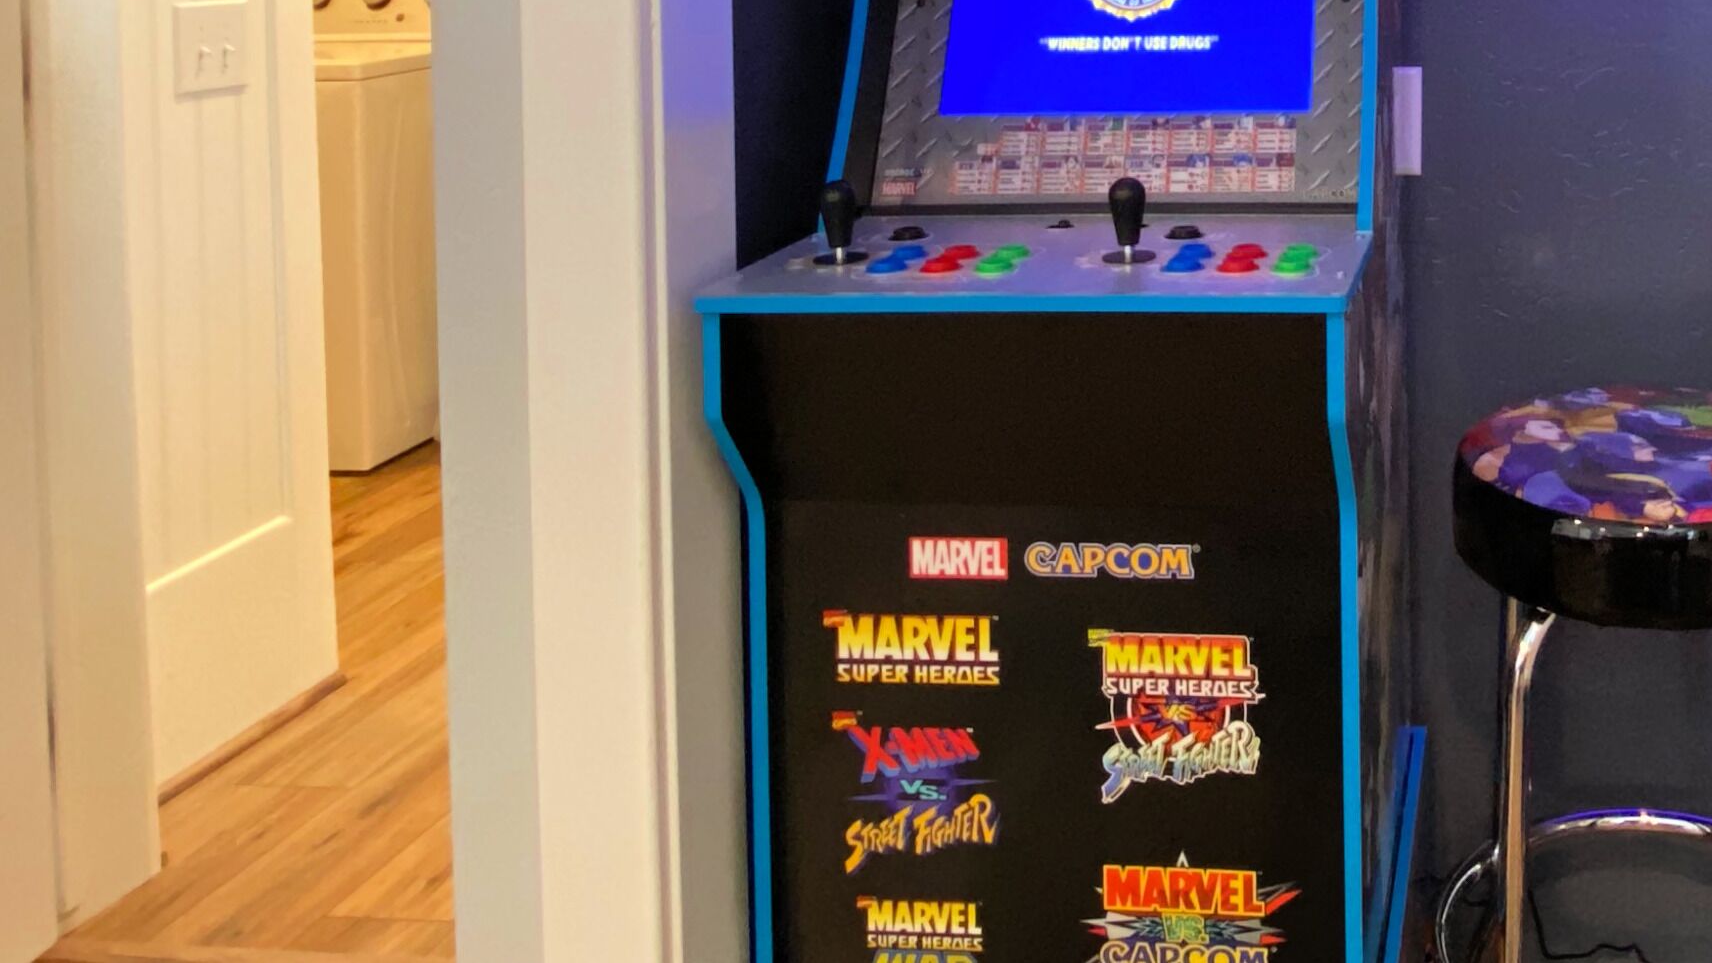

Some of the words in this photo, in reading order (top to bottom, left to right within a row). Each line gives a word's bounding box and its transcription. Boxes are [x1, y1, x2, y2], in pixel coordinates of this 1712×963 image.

[1102, 35, 1142, 51] DON'T
[1144, 35, 1167, 51] USE
[911, 539, 1006, 576] MARVEL
[1024, 541, 1194, 578] CAPCOM
[838, 614, 999, 662] MARVEL
[837, 664, 909, 682] SUPER
[914, 666, 1000, 685] HEROES
[1105, 637, 1252, 678] MARVEL
[1106, 678, 1170, 696] SUPER
[1174, 680, 1252, 699] HEROES
[1168, 702, 1194, 722] VS
[848, 726, 981, 783] X-MEN
[1101, 732, 1171, 803] STREET
[1171, 721, 1261, 783] FIGHTER
[900, 779, 947, 801] VS.
[844, 805, 914, 874] STREET
[912, 793, 997, 855] FIGHTER
[1103, 865, 1266, 917] MARVEL
[867, 900, 983, 935] MARVEL
[1162, 913, 1210, 944] VS.
[866, 934, 919, 949] SUPER
[922, 936, 984, 953] HEROES
